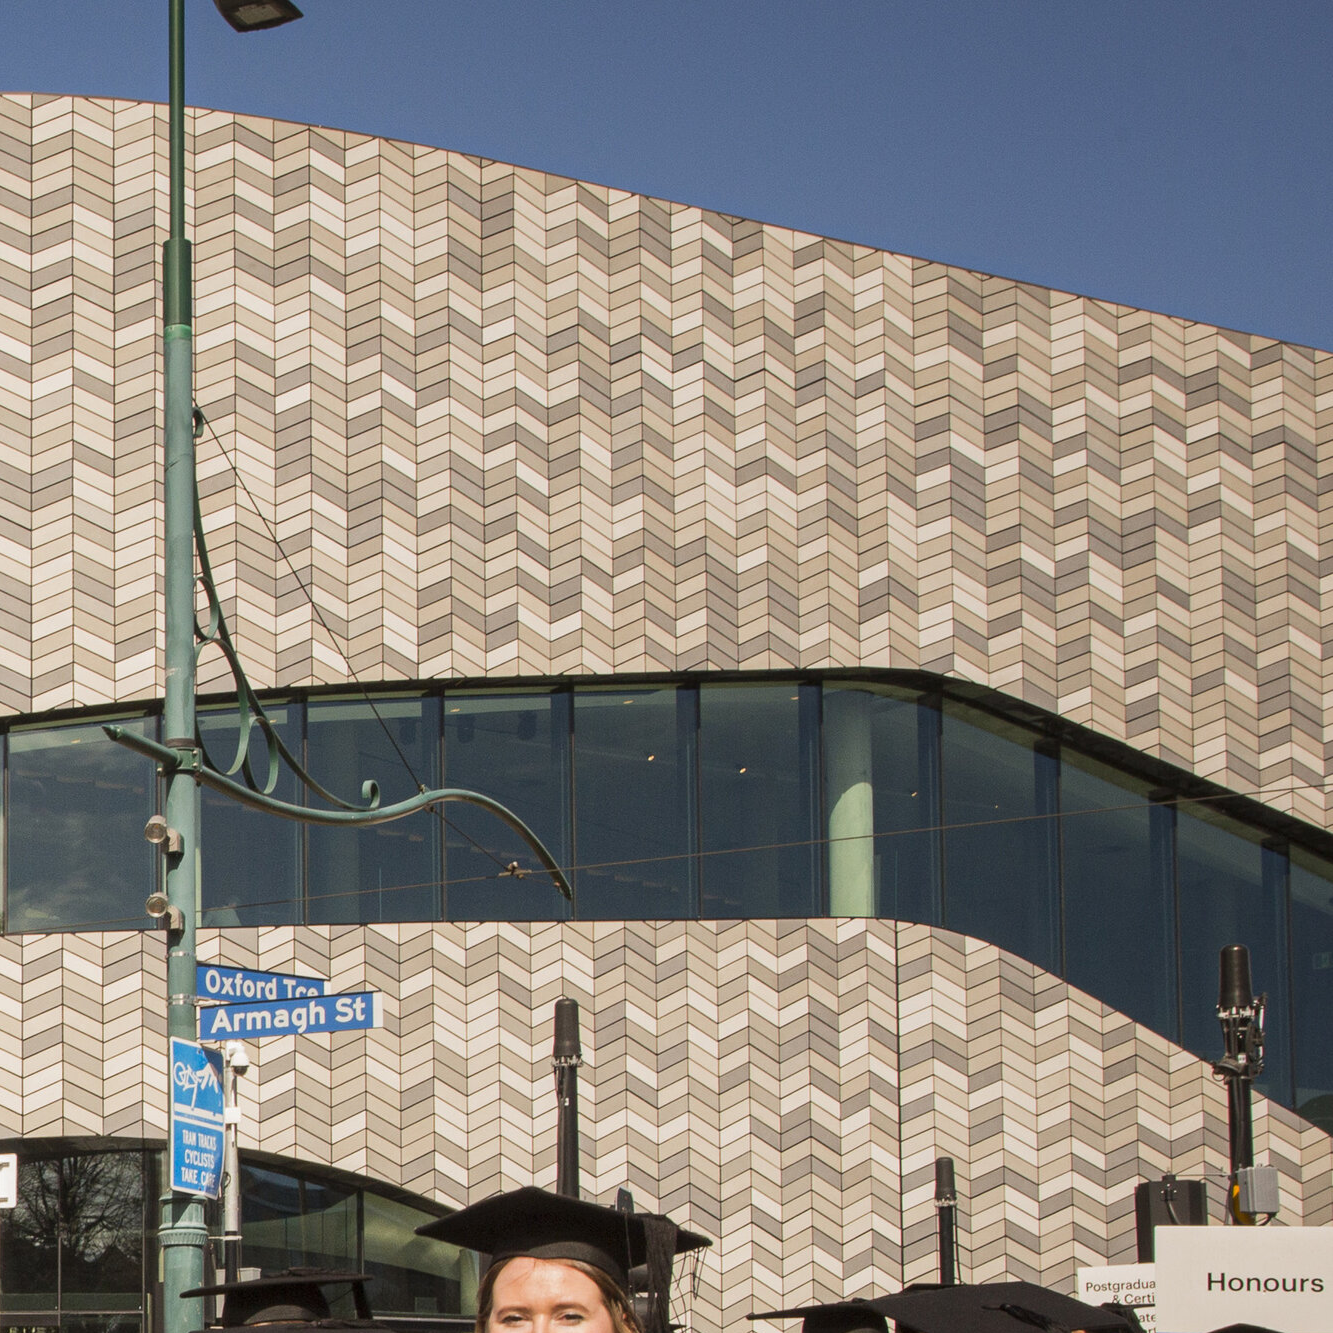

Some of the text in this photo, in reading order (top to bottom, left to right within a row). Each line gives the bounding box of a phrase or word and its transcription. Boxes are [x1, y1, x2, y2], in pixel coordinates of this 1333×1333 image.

[205, 969, 318, 1000] Oxford Tce
[210, 997, 366, 1034] Armagh St
[198, 1133, 216, 1151] TRACKS
[184, 1149, 215, 1169] CYCLISTS
[181, 1166, 198, 1184] TAKE
[1086, 1278, 1156, 1293] Postgradua
[1207, 1271, 1325, 1293] Honours
